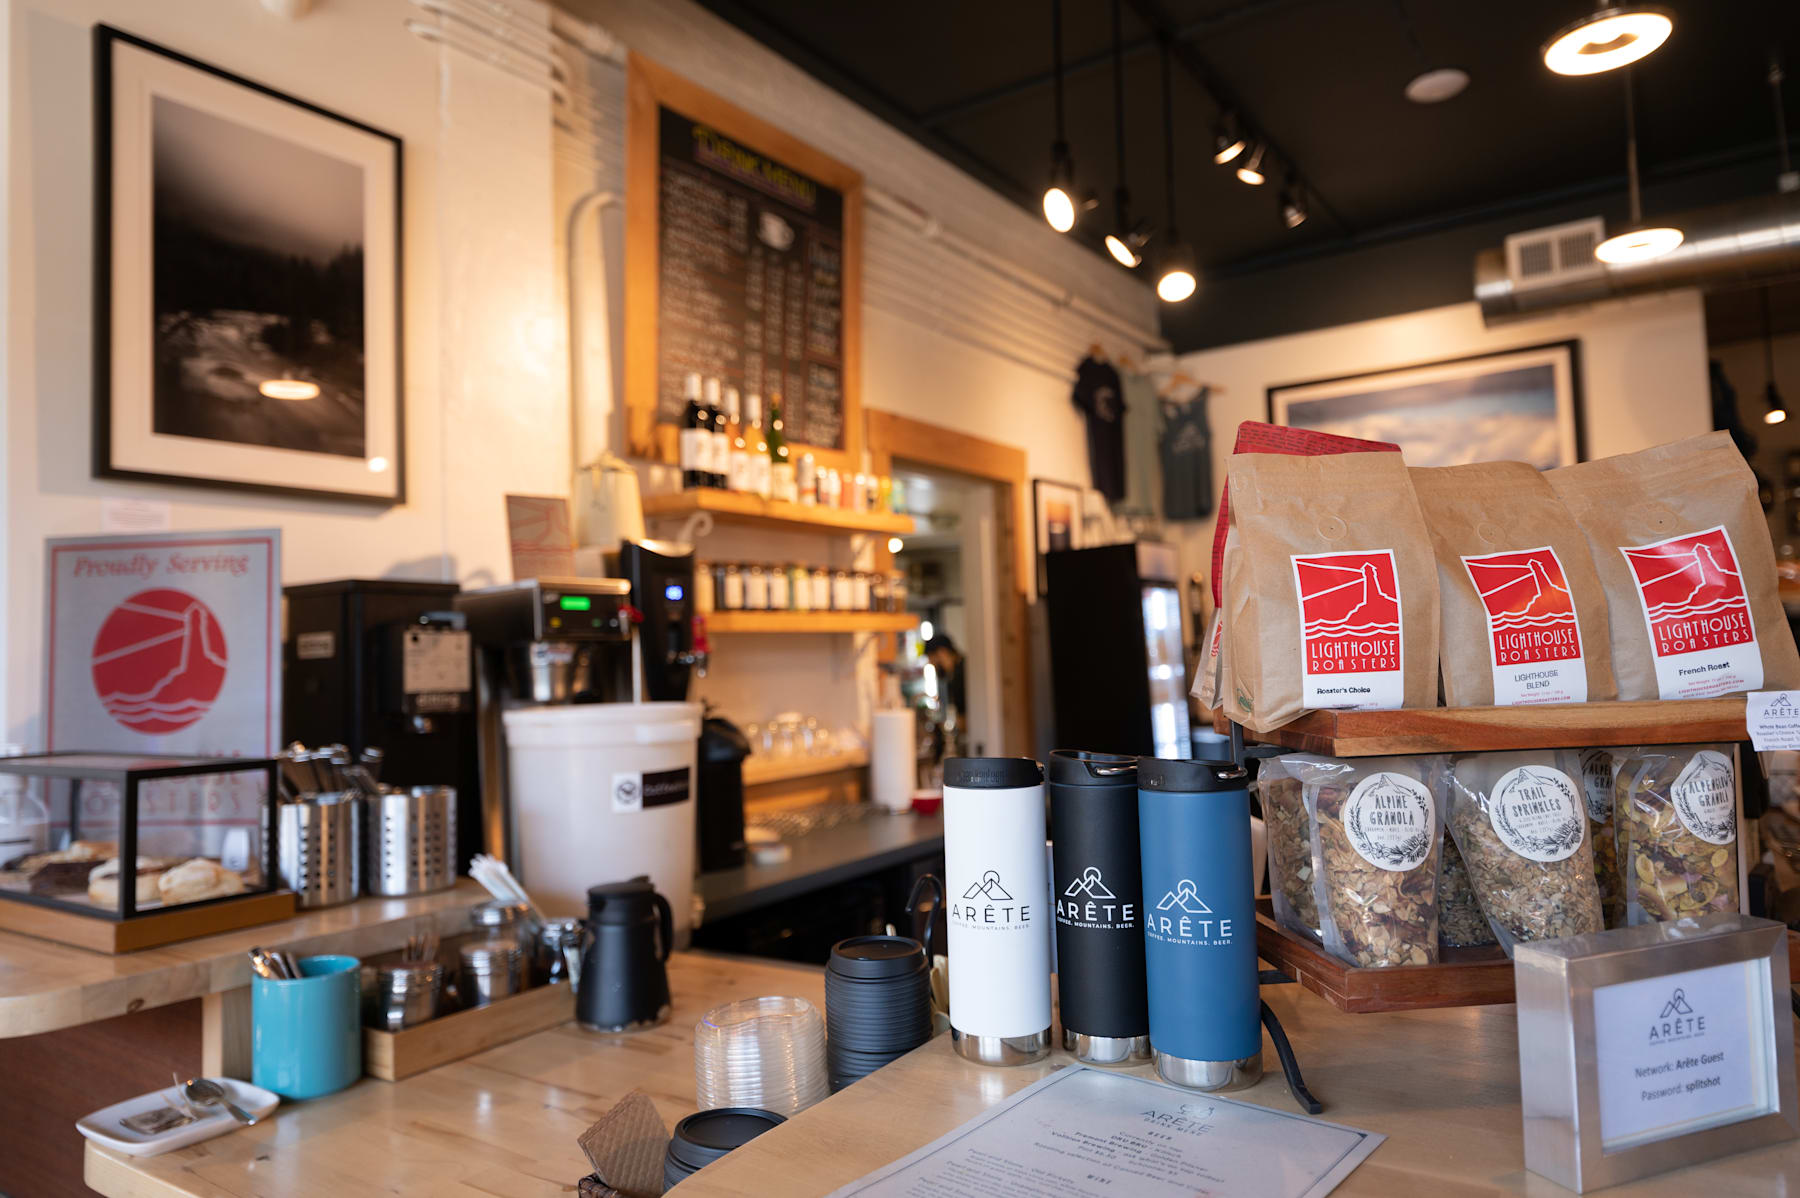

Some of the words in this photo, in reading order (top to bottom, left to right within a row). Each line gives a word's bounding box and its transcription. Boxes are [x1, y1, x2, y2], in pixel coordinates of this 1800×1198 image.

[74, 554, 158, 579] Proudly
[166, 553, 250, 576] Serving
[1658, 612, 1746, 641] LIGHTHOUSE
[1498, 628, 1575, 650] LIGHTHOUSE
[1662, 629, 1750, 653] ROASTERS
[1311, 640, 1396, 659] LIGHTHOUSE
[1501, 645, 1577, 663] ROASTERS
[1312, 657, 1396, 672] ROASTERS
[1678, 666, 1707, 676] French
[1707, 661, 1731, 672] Roast
[1514, 669, 1559, 682] LIGHTHOUSE
[1316, 687, 1348, 695] Roaster's
[1348, 686, 1371, 694] Choice
[1526, 680, 1550, 690] BLEND
[1764, 707, 1799, 716] ARÊTE
[1375, 794, 1408, 809] ALPINE
[1518, 786, 1546, 801] TRAIL
[1512, 798, 1562, 818] SPRINKLES
[1370, 811, 1415, 826] GRANOLA
[952, 903, 1031, 923] ARÊTE
[1056, 899, 1135, 922] ARÊTE
[1074, 921, 1114, 930] MOUNTAINS.
[1115, 922, 1135, 930] BEER.
[1147, 912, 1233, 938] ARÊTE
[1167, 937, 1211, 946] MOUNTAINS.
[1649, 1016, 1706, 1041] ARÊTE
[1634, 1062, 1674, 1078] Network:
[1675, 1056, 1699, 1070] Arête
[1700, 1052, 1725, 1065] Guest
[1641, 1085, 1682, 1101] Password:
[1685, 1076, 1721, 1094] splitshot
